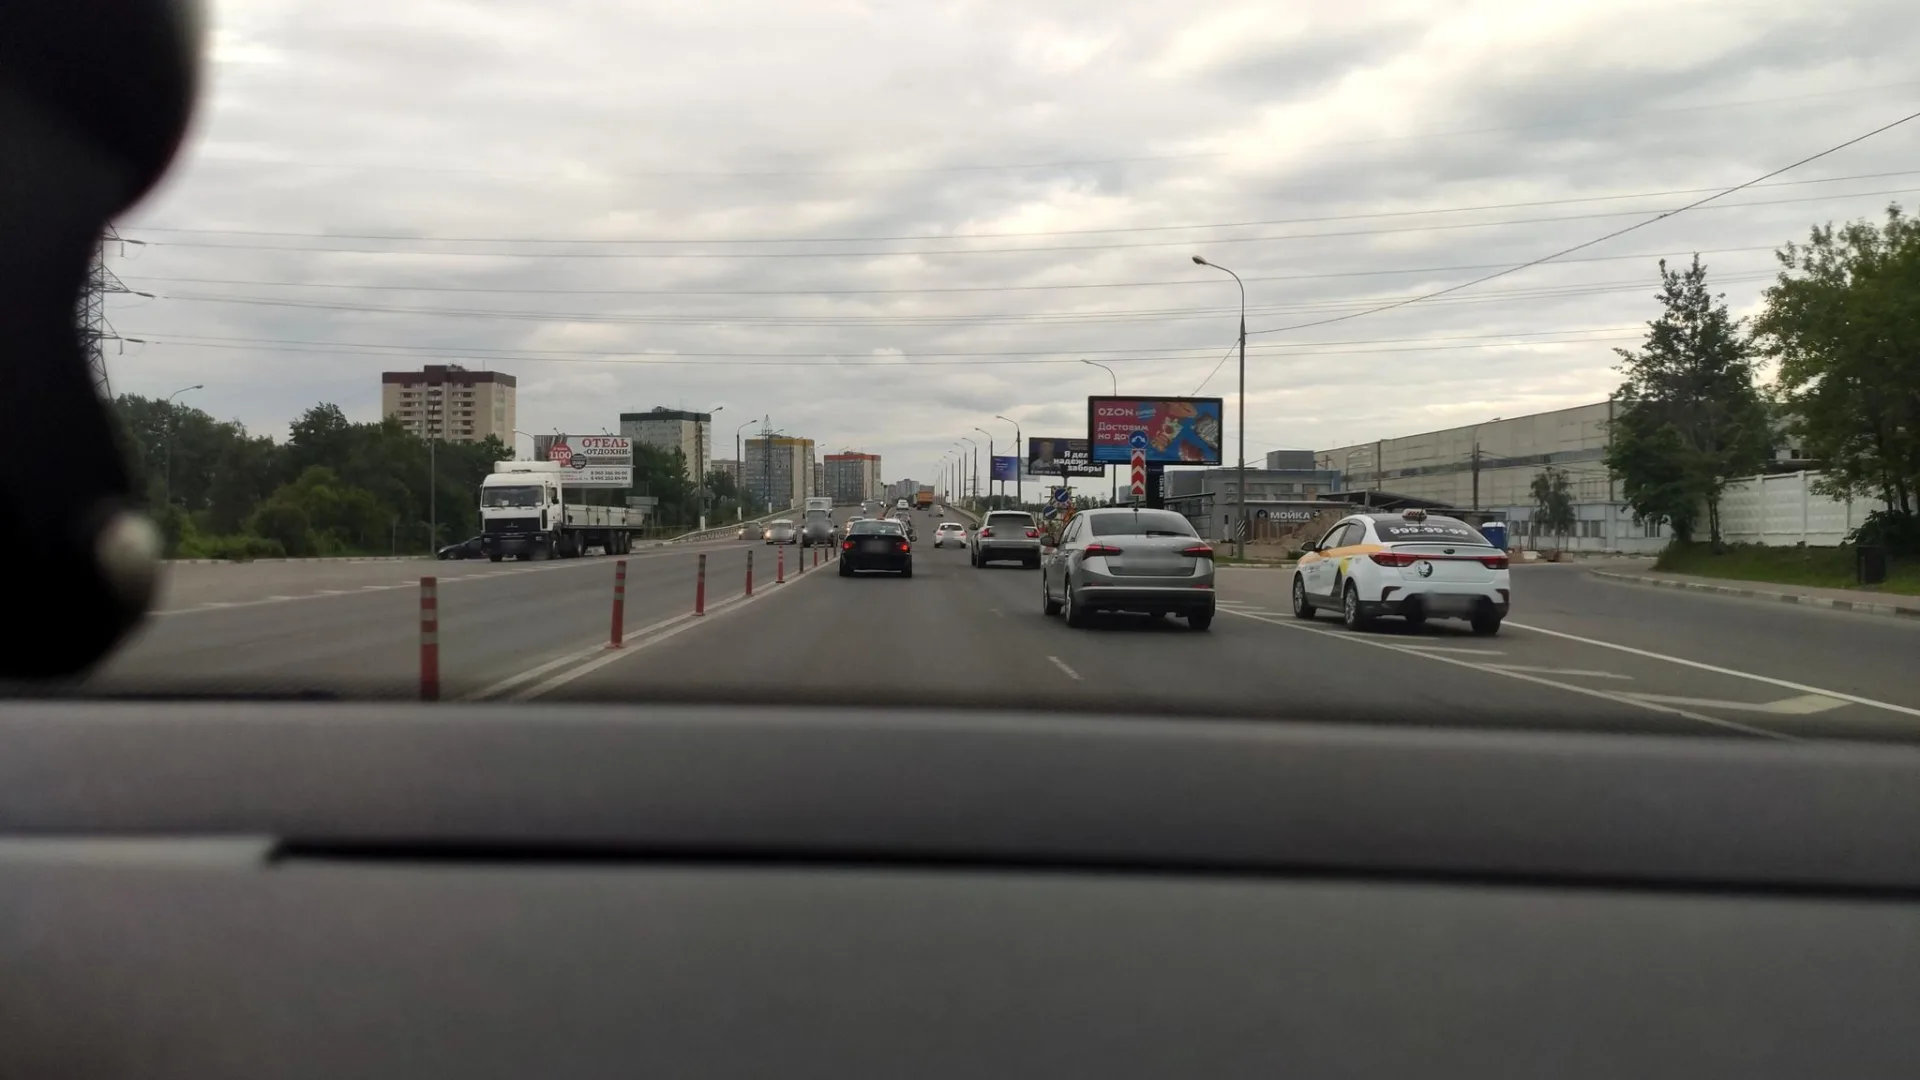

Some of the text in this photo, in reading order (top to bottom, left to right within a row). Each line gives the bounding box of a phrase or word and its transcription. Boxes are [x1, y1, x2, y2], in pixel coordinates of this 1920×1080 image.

[1098, 408, 1134, 416] OZON
[1098, 422, 1148, 431] Доставим
[1114, 433, 1129, 441] да
[582, 438, 629, 448] ОТЕЛЬ
[549, 451, 571, 459] 1100
[1064, 450, 1071, 458] Я
[1270, 510, 1310, 519] МОЙКА
